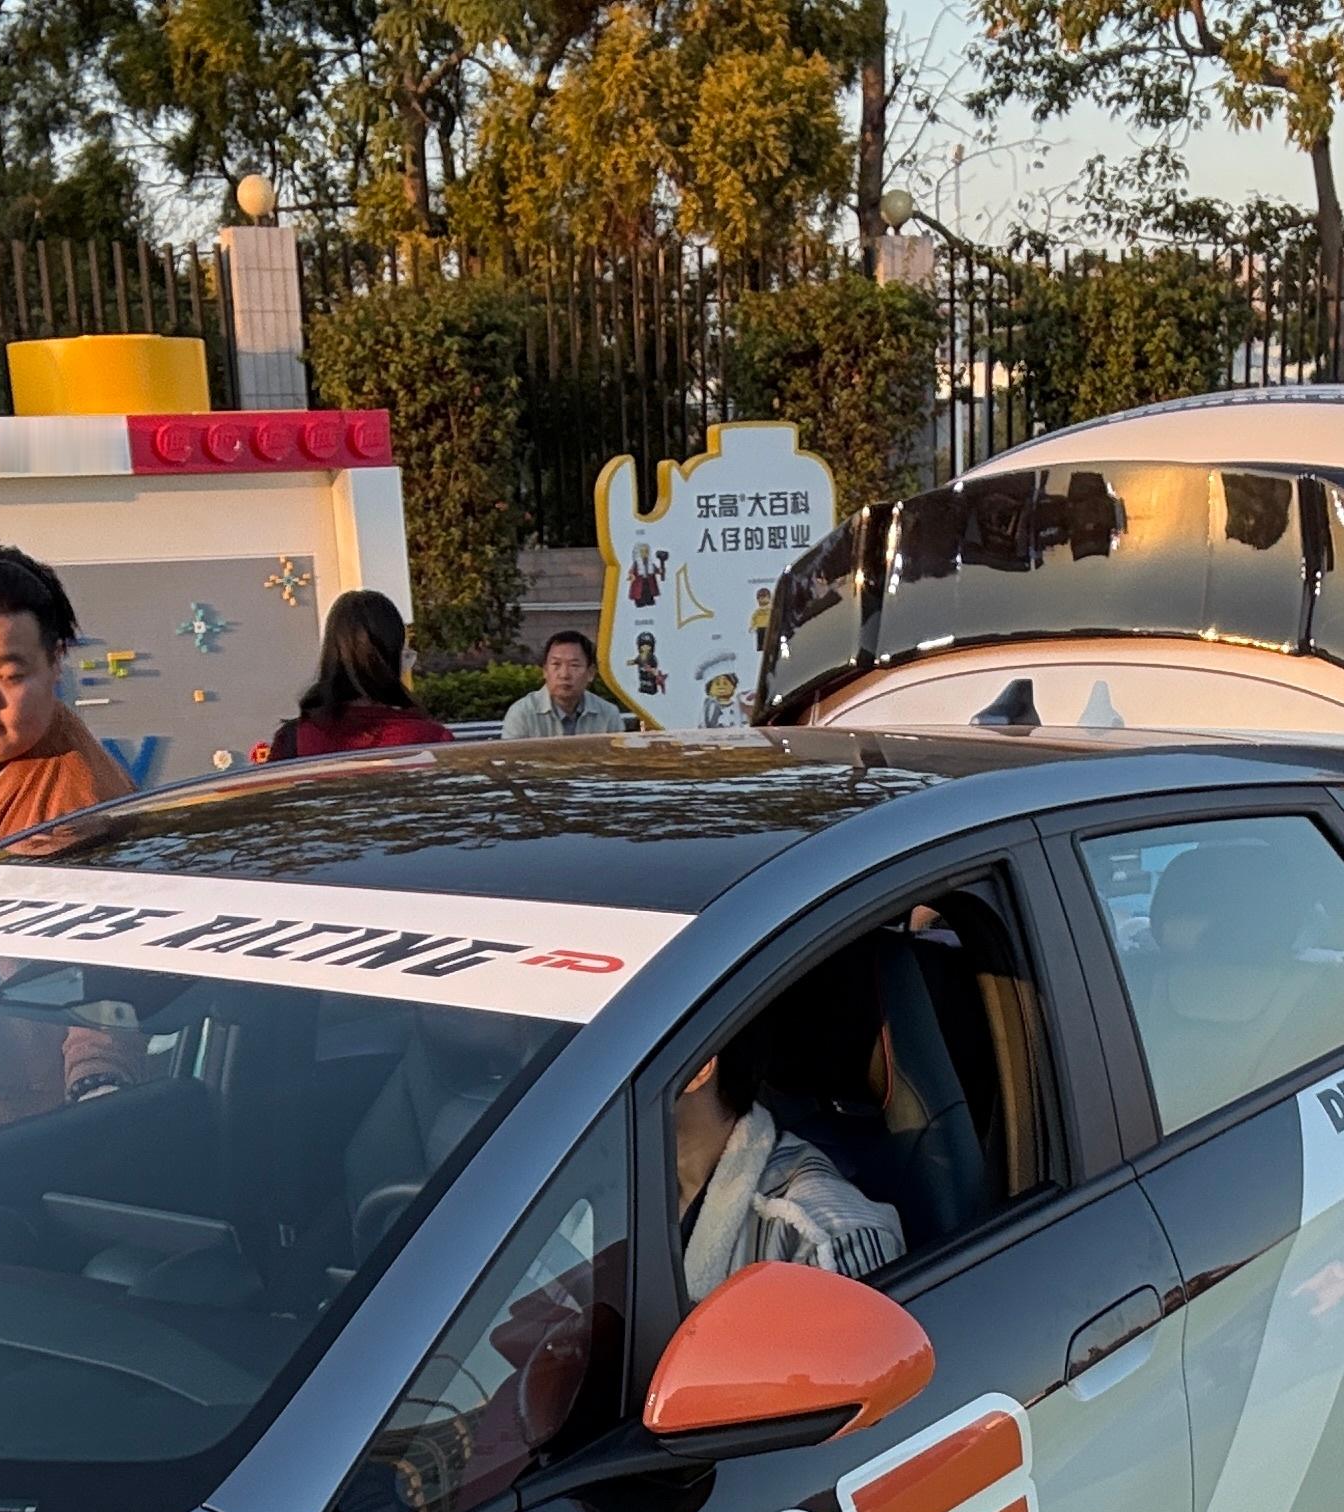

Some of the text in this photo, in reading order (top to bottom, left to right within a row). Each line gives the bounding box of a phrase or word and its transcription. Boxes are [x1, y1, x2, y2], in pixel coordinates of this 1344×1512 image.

[696, 524, 811, 554] 人仔的职业
[142, 914, 533, 978] RACING
